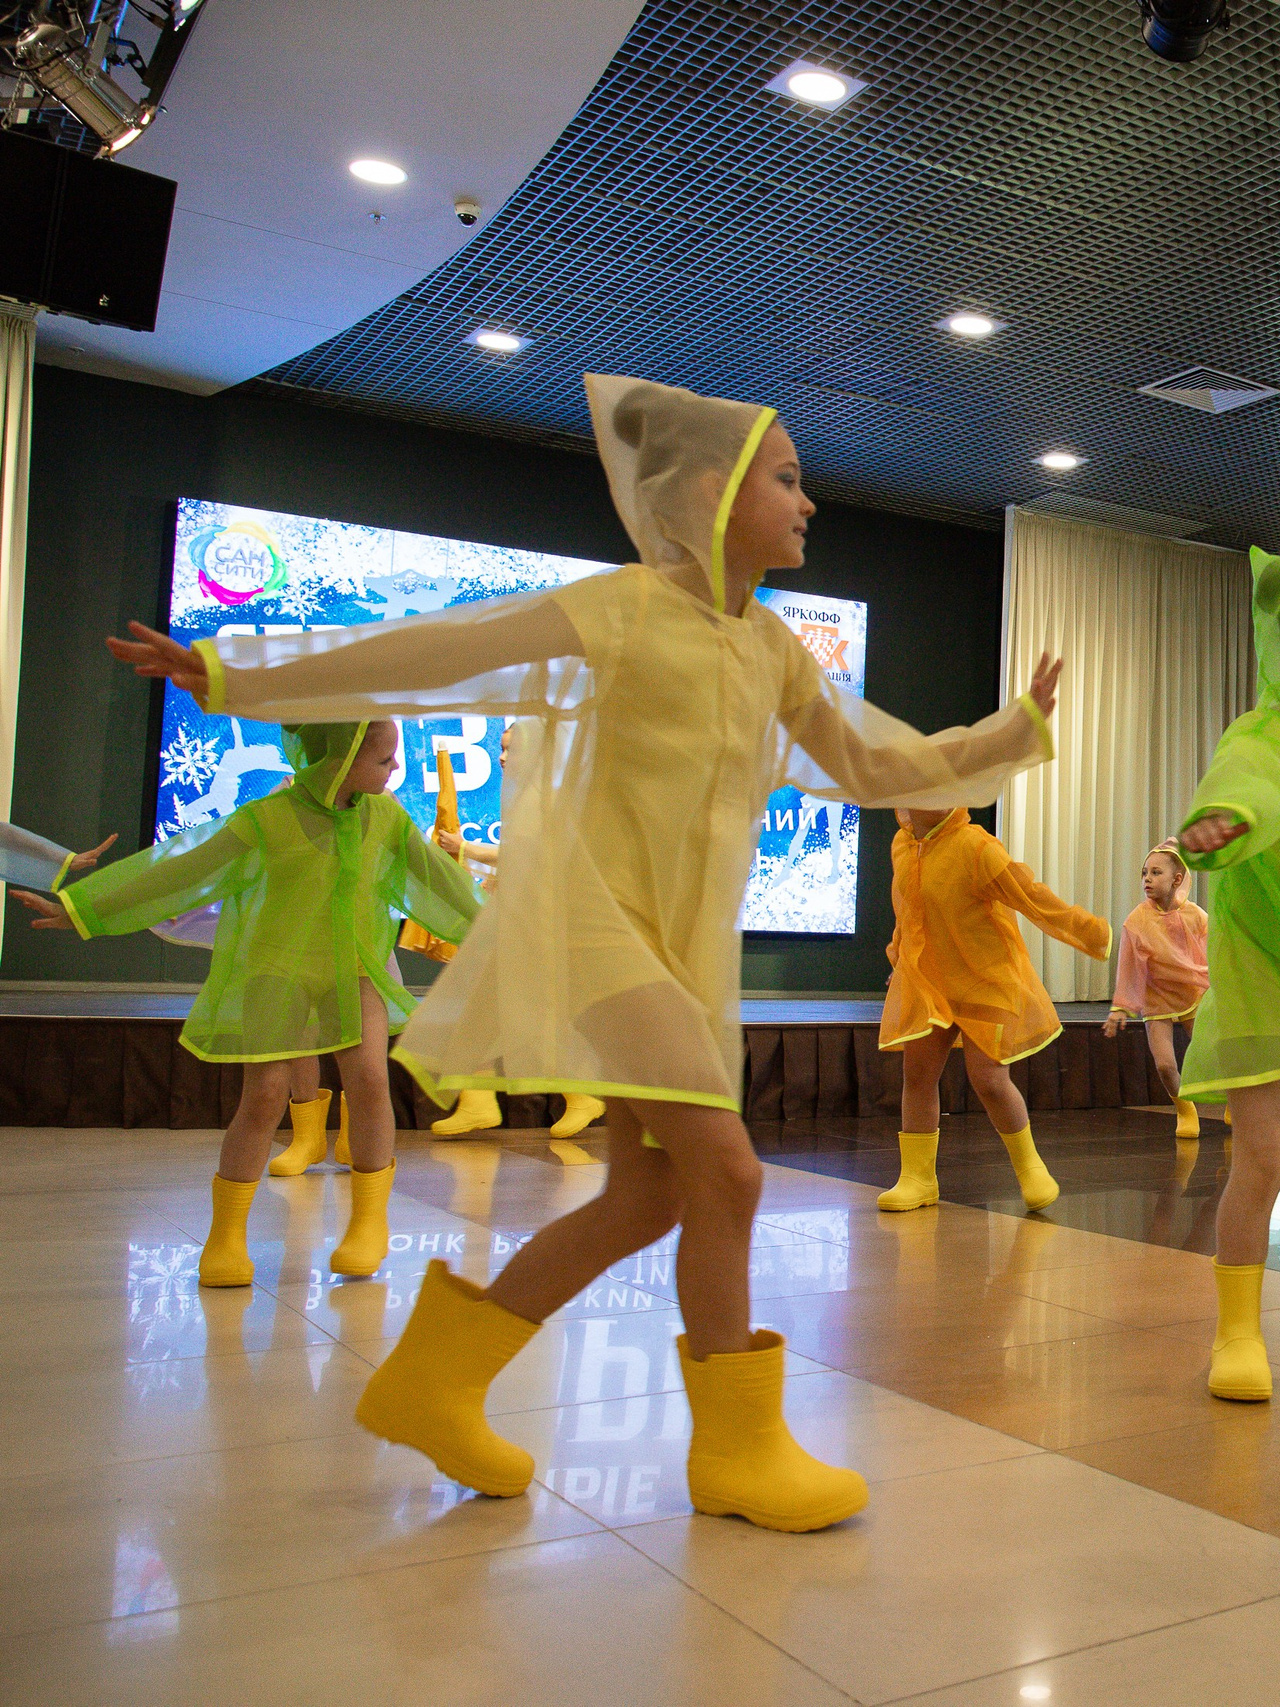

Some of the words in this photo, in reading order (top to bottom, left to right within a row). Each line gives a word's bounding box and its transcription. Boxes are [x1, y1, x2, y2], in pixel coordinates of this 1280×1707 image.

[215, 546, 266, 567] САН
[213, 562, 264, 582] СИТИ
[782, 605, 841, 624] ЯРКОФФ
